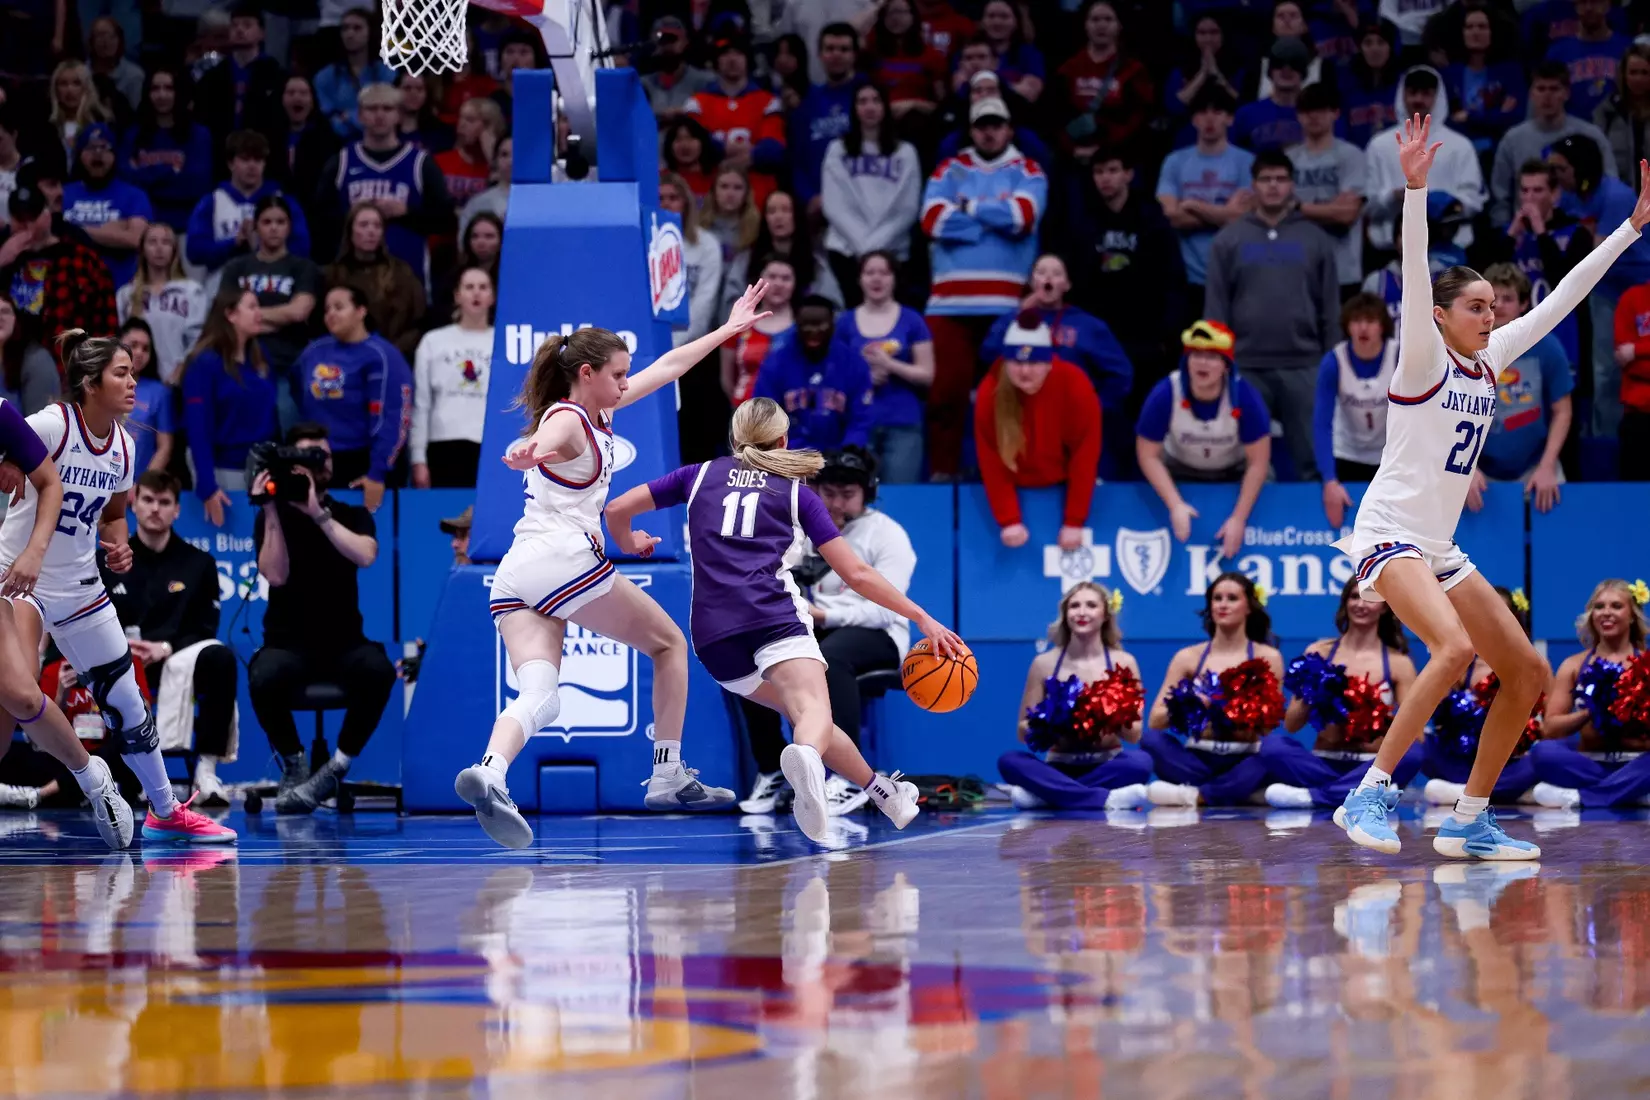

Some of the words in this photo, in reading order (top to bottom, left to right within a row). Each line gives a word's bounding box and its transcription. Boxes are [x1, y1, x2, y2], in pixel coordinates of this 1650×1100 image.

[1445, 421, 1484, 475] 21
[727, 468, 768, 488] SIDES
[55, 491, 106, 536] 24
[721, 491, 760, 538] 11
[216, 533, 254, 553] Blue
[1244, 526, 1334, 546] BlueCross
